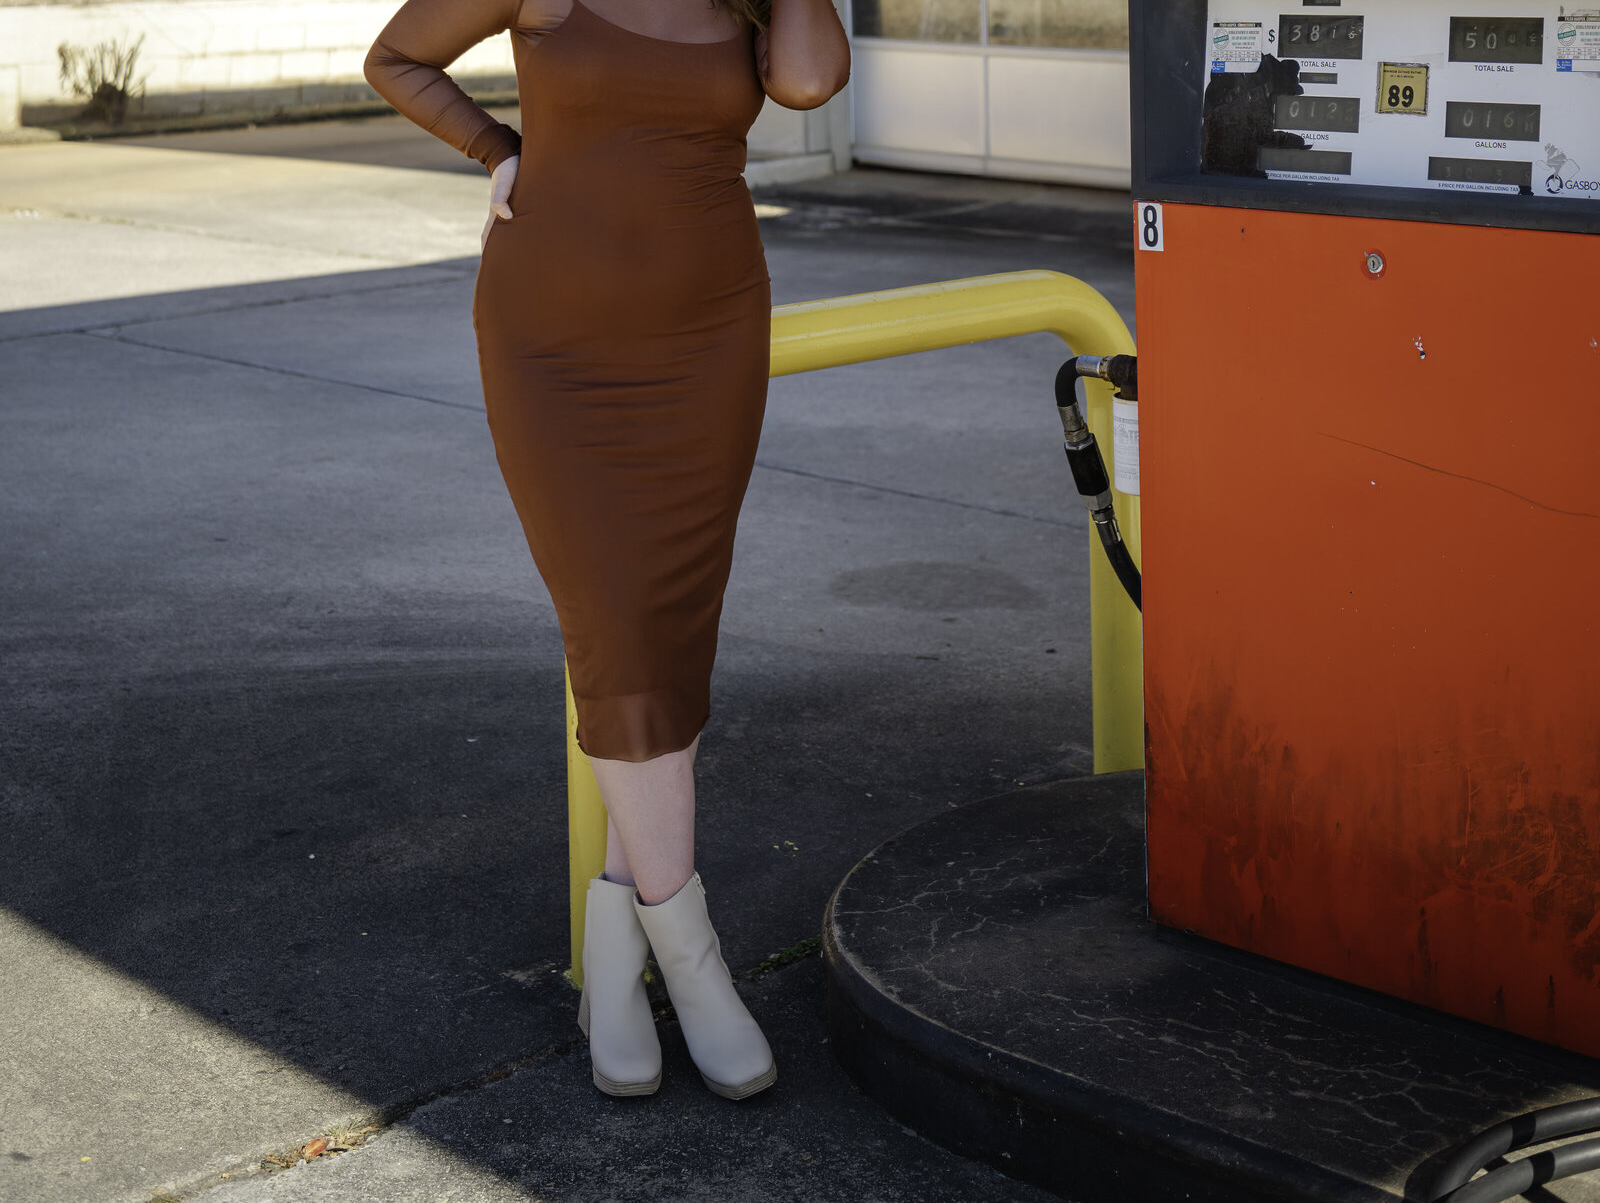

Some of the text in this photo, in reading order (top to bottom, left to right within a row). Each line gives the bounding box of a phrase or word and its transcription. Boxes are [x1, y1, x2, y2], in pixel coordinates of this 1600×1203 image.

[1268, 29, 1276, 44] $
[1387, 84, 1414, 108] 89
[1300, 133, 1330, 141] GALLONS
[1474, 141, 1507, 149] GALLONS
[1143, 204, 1159, 248] 8
